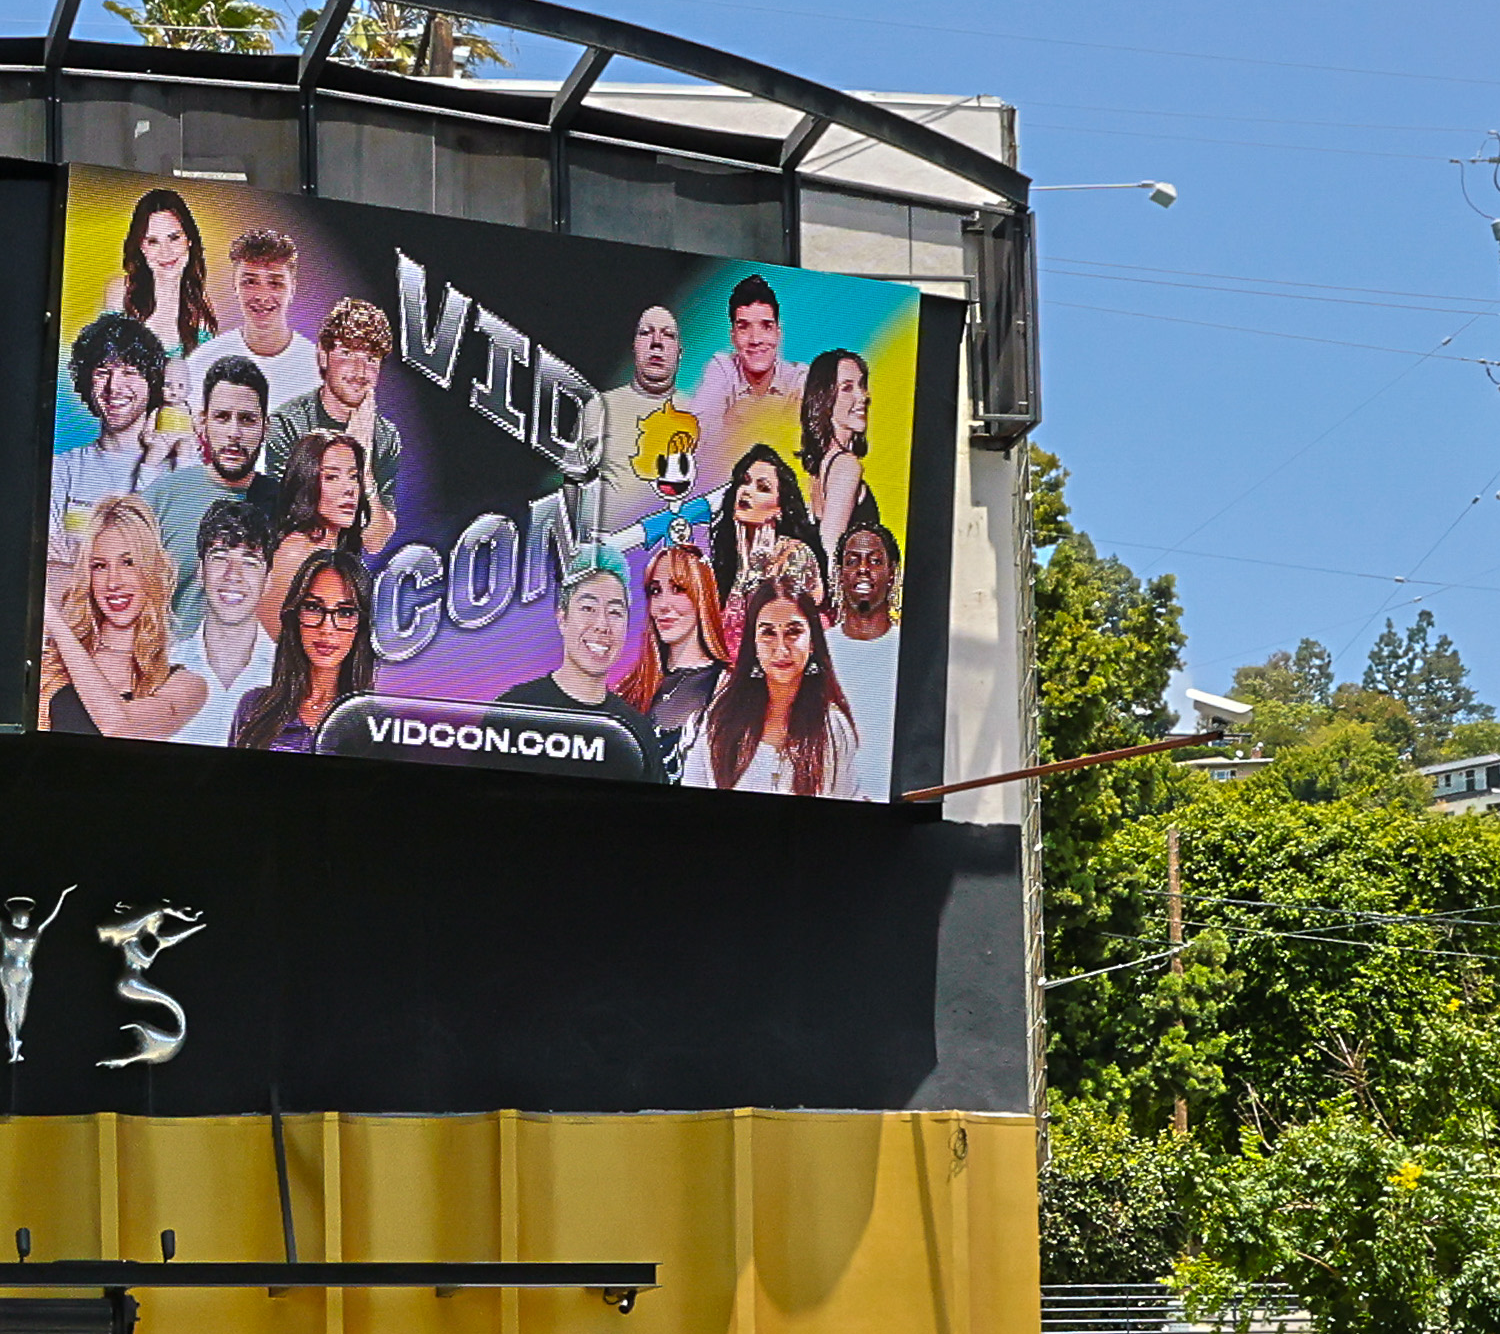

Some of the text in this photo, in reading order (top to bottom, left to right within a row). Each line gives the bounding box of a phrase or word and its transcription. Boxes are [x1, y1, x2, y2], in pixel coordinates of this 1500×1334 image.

[395, 248, 605, 475] VID
[370, 475, 601, 662] CON
[366, 715, 606, 762] VIDCON.COM
